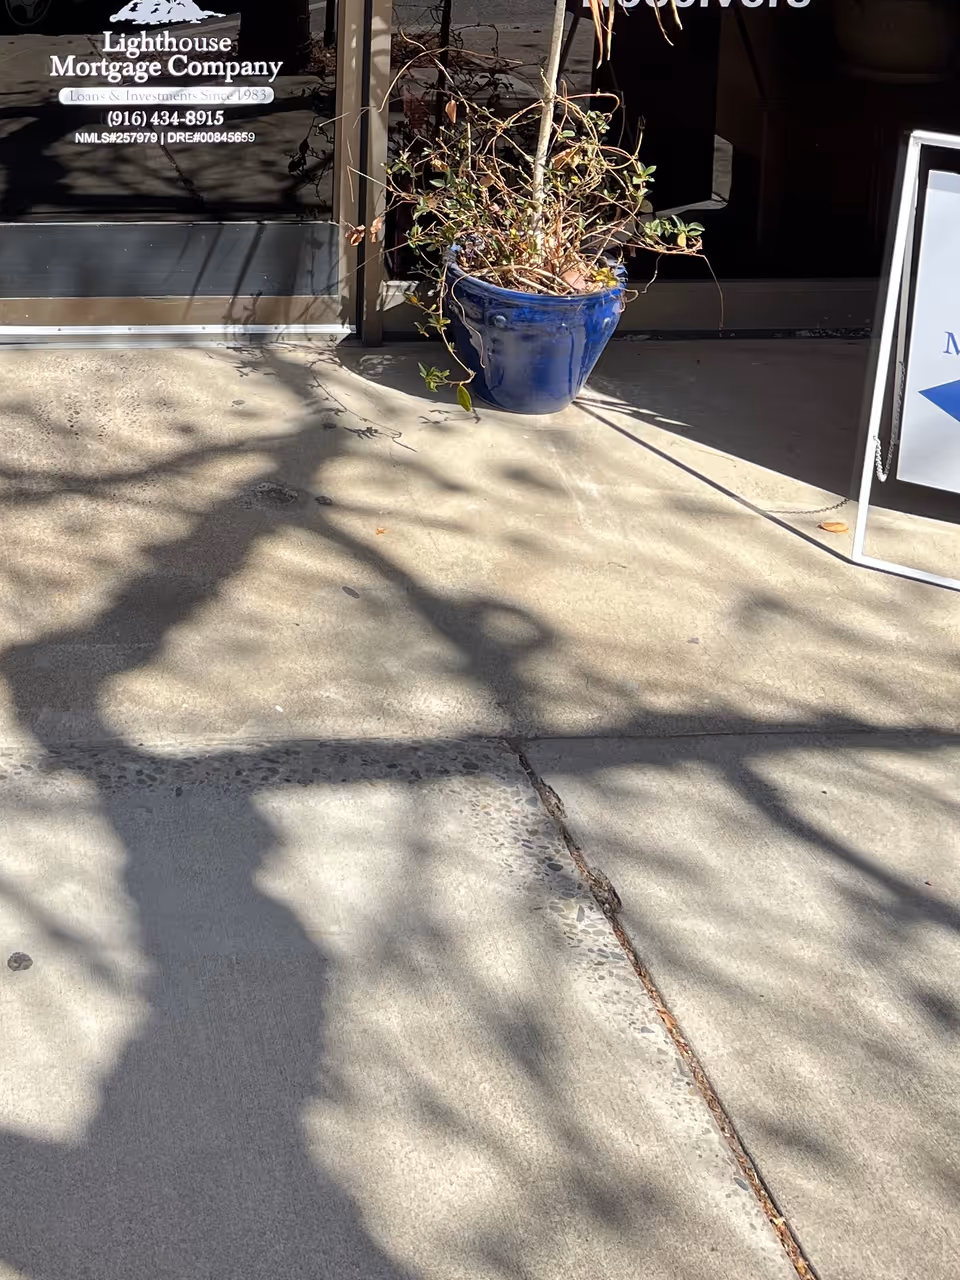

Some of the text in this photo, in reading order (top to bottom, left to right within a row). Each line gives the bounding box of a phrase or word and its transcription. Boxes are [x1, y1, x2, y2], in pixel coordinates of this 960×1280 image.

[102, 30, 232, 58] Lighthouse
[49, 54, 284, 83] Mortgage Company
[69, 88, 268, 102] Loans & Investments Since 1983
[107, 110, 225, 128] (916) 434-8915
[75, 131, 158, 144] NMLS#257979
[167, 131, 256, 144] DRE#00845659
